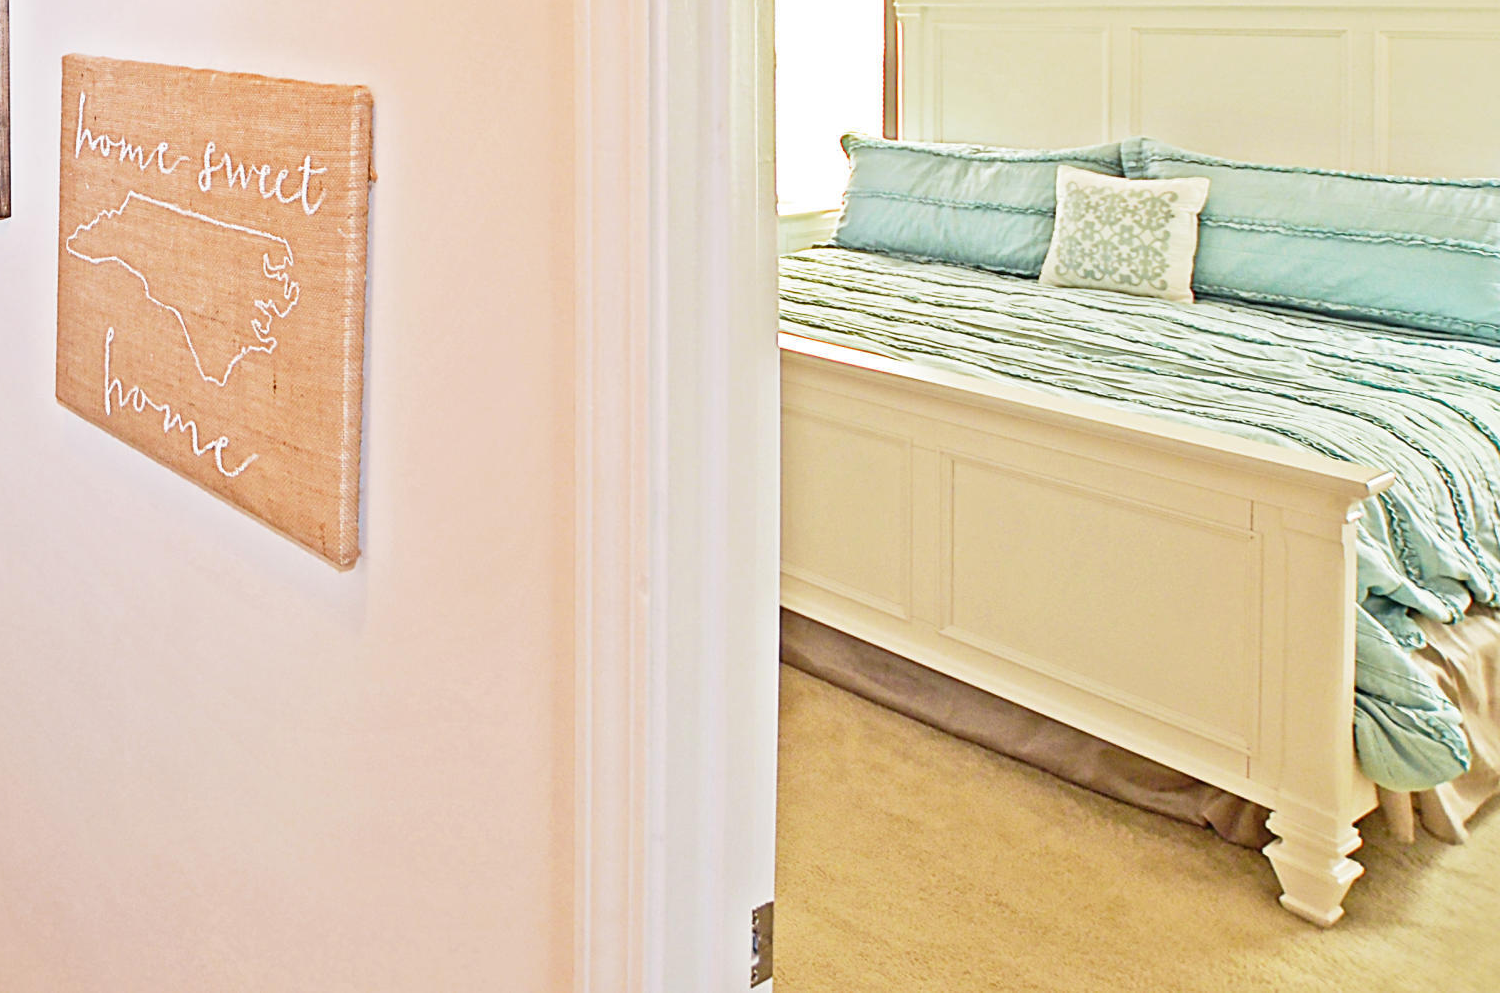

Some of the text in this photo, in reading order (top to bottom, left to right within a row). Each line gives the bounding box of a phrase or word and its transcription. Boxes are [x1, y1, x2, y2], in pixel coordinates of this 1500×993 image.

[74, 90, 329, 216] home sweet
[104, 326, 260, 478] home
